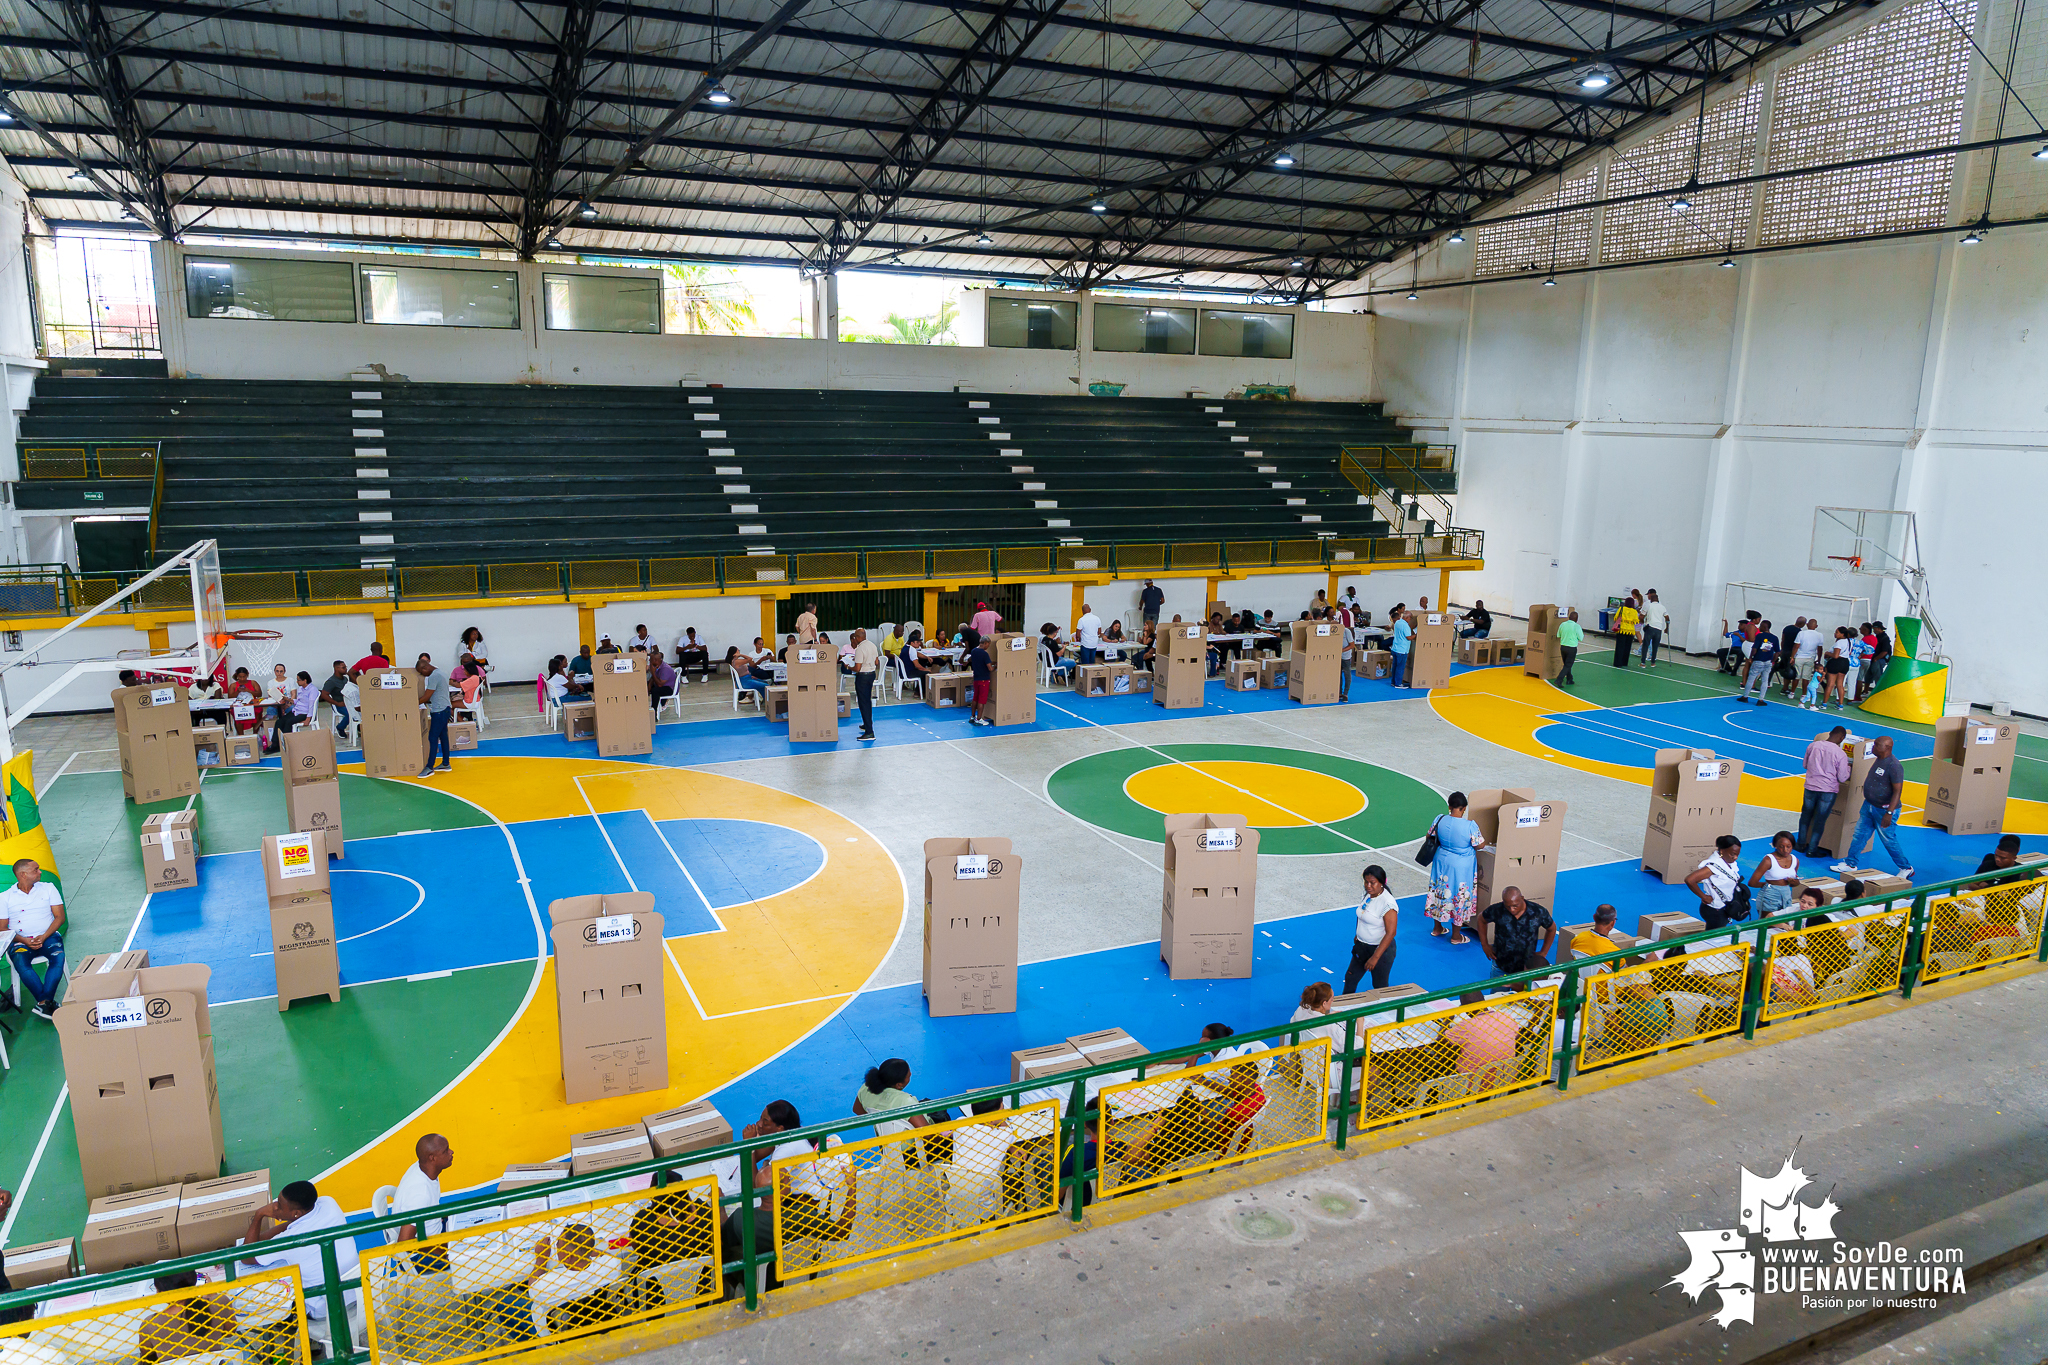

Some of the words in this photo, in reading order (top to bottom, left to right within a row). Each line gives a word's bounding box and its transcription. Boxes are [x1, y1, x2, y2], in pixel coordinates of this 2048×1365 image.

[600, 930, 620, 938] MESA
[279, 938, 330, 949] REGISTRADURÍA
[102, 1014, 128, 1024] MESA
[130, 1012, 142, 1020] 12
